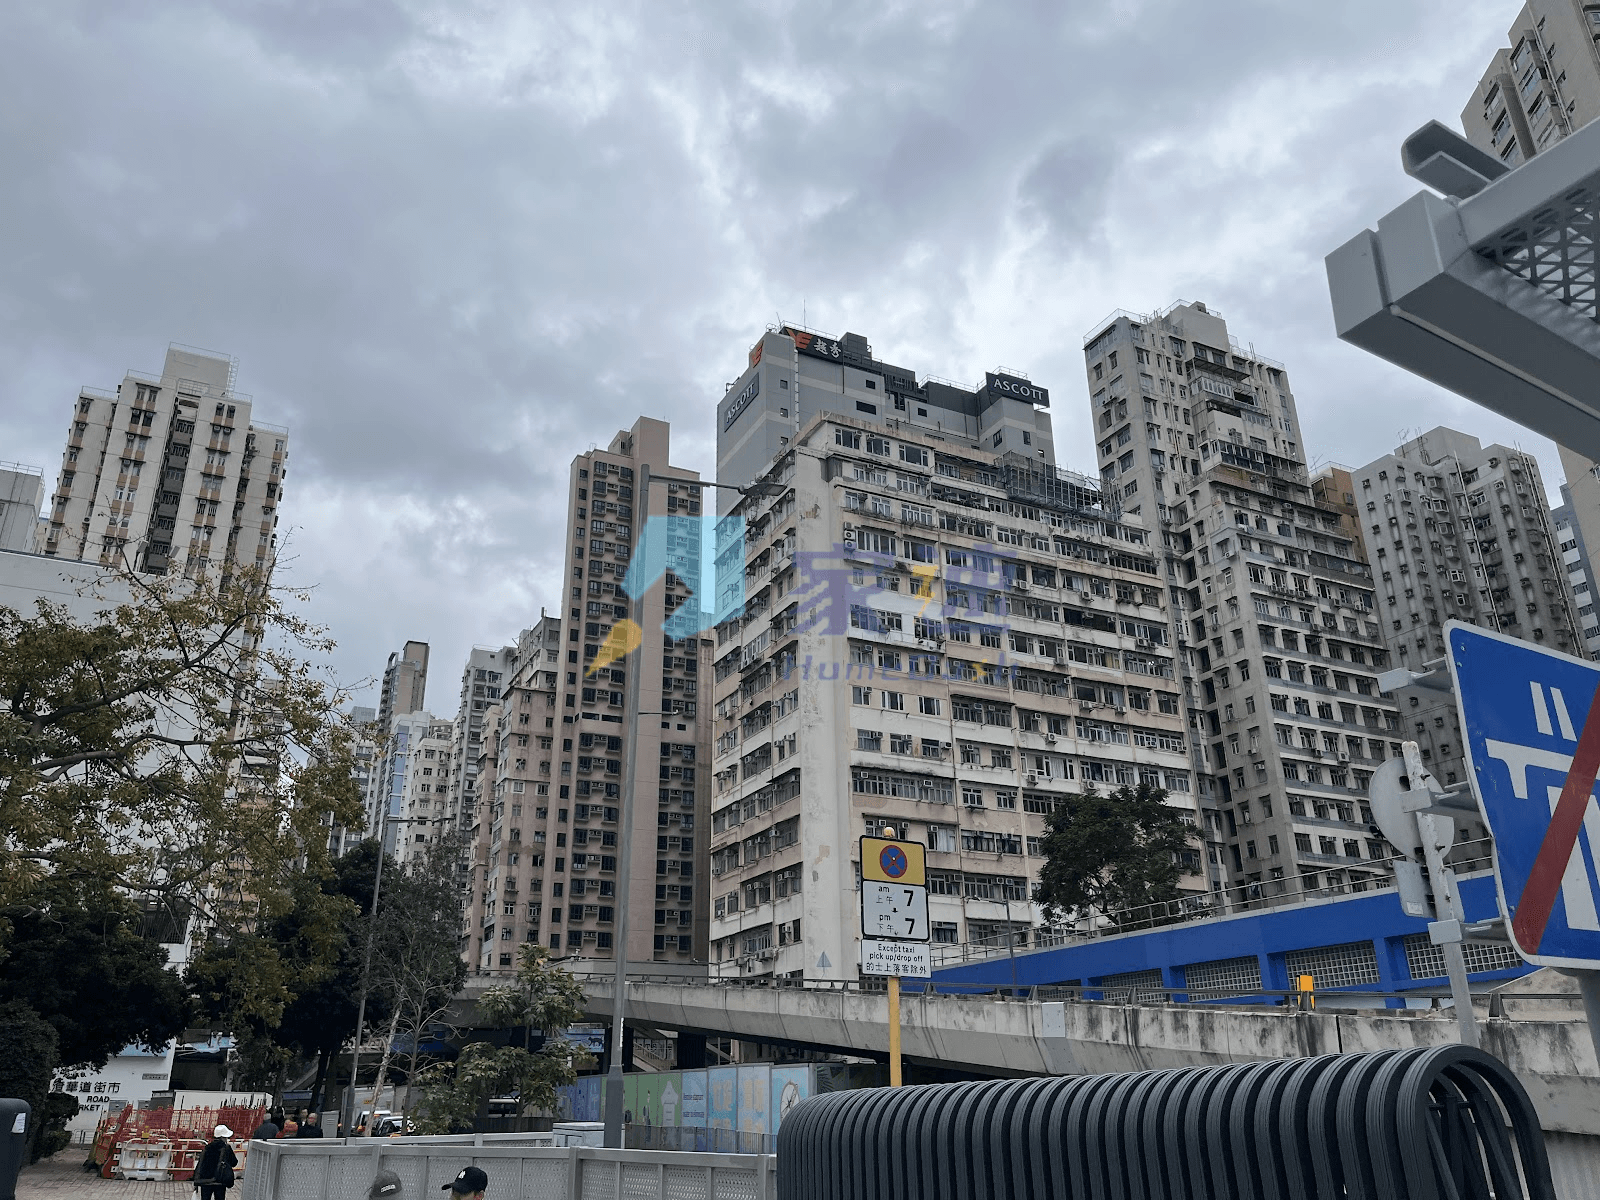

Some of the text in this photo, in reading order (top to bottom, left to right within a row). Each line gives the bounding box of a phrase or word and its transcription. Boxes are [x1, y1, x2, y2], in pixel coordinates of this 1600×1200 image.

[994, 379, 1043, 399] ASCOTT
[726, 382, 755, 423] ASCOTT
[876, 895, 894, 905] 上午
[904, 890, 913, 906] 7
[877, 923, 894, 933] 下午
[905, 918, 914, 934] 7
[878, 943, 901, 953] Except
[869, 952, 923, 963] pick up/drop off
[866, 962, 927, 975] 的士上落客除外
[86, 1095, 110, 1103] ROAD
[78, 1104, 101, 1112] RKET
